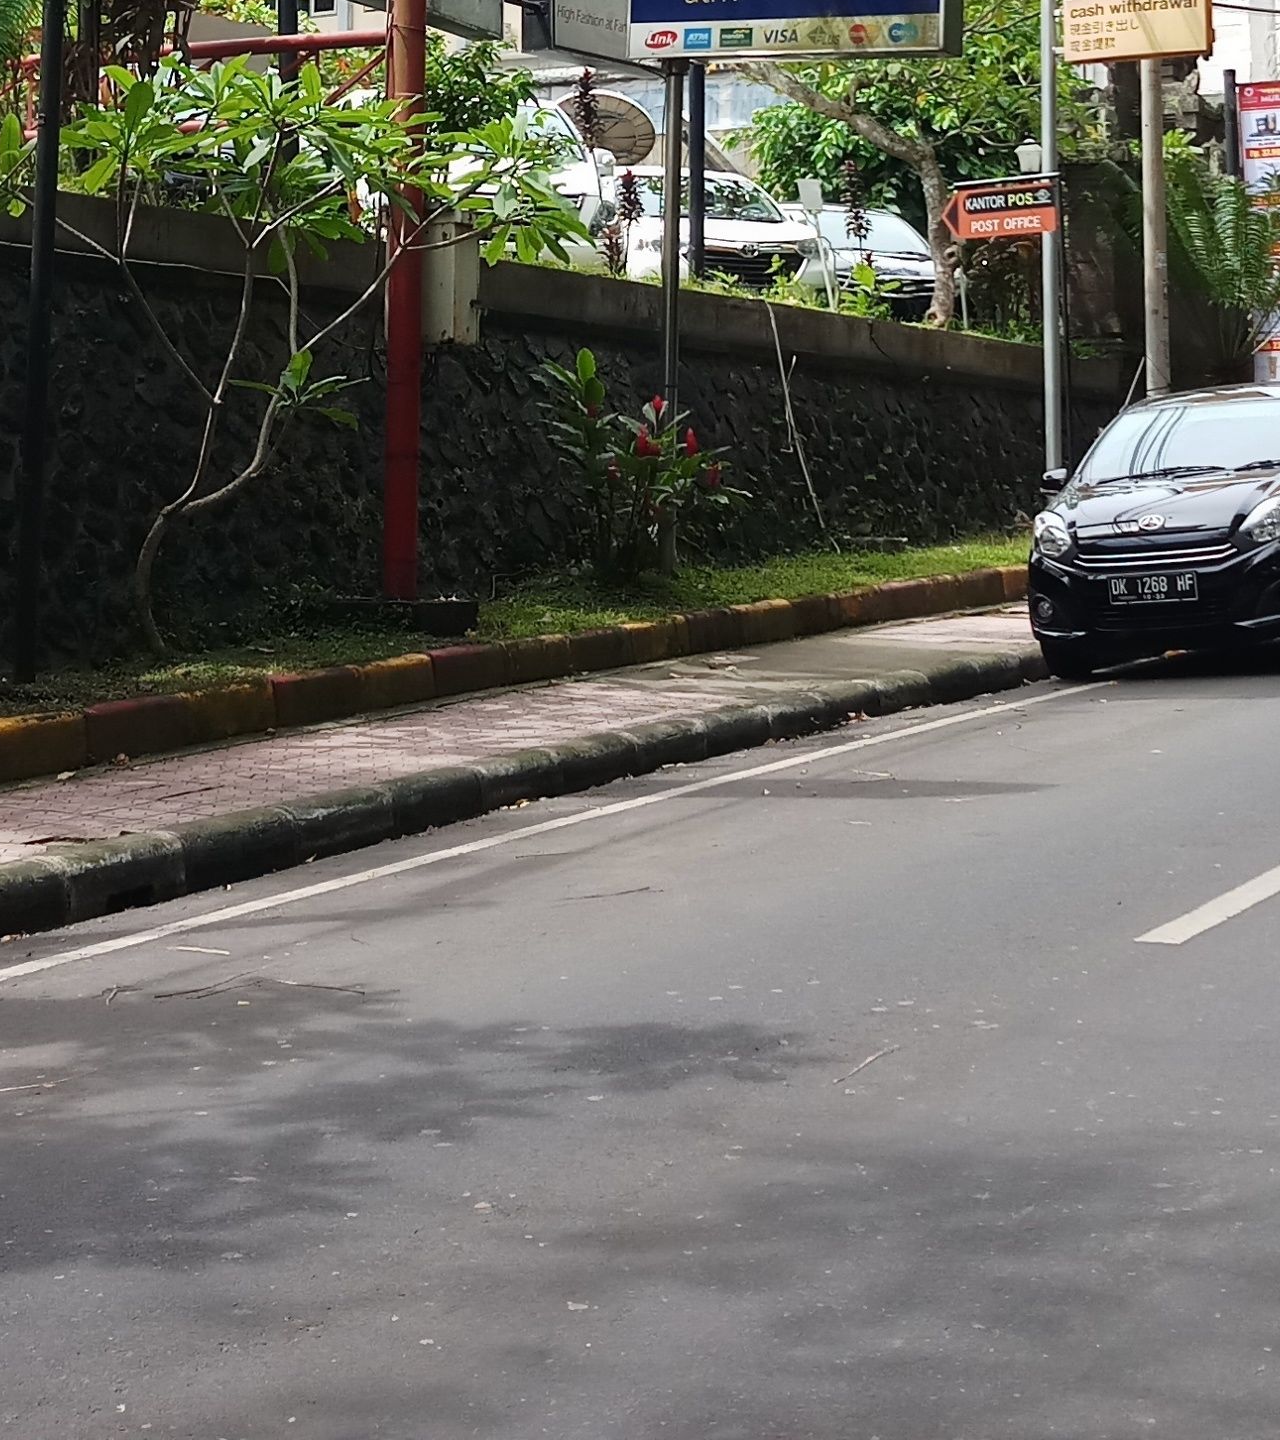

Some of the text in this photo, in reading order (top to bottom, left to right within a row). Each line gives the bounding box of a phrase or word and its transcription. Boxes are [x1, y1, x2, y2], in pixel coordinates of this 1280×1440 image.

[557, 4, 576, 24] High
[576, 10, 605, 27] Fashion
[1070, 3, 1104, 19] cash
[763, 28, 799, 44] VISA
[964, 192, 1034, 211] KANTOR POS
[970, 216, 1042, 233] POST OFFICE
[1111, 574, 1194, 595] DK 1268 HF
